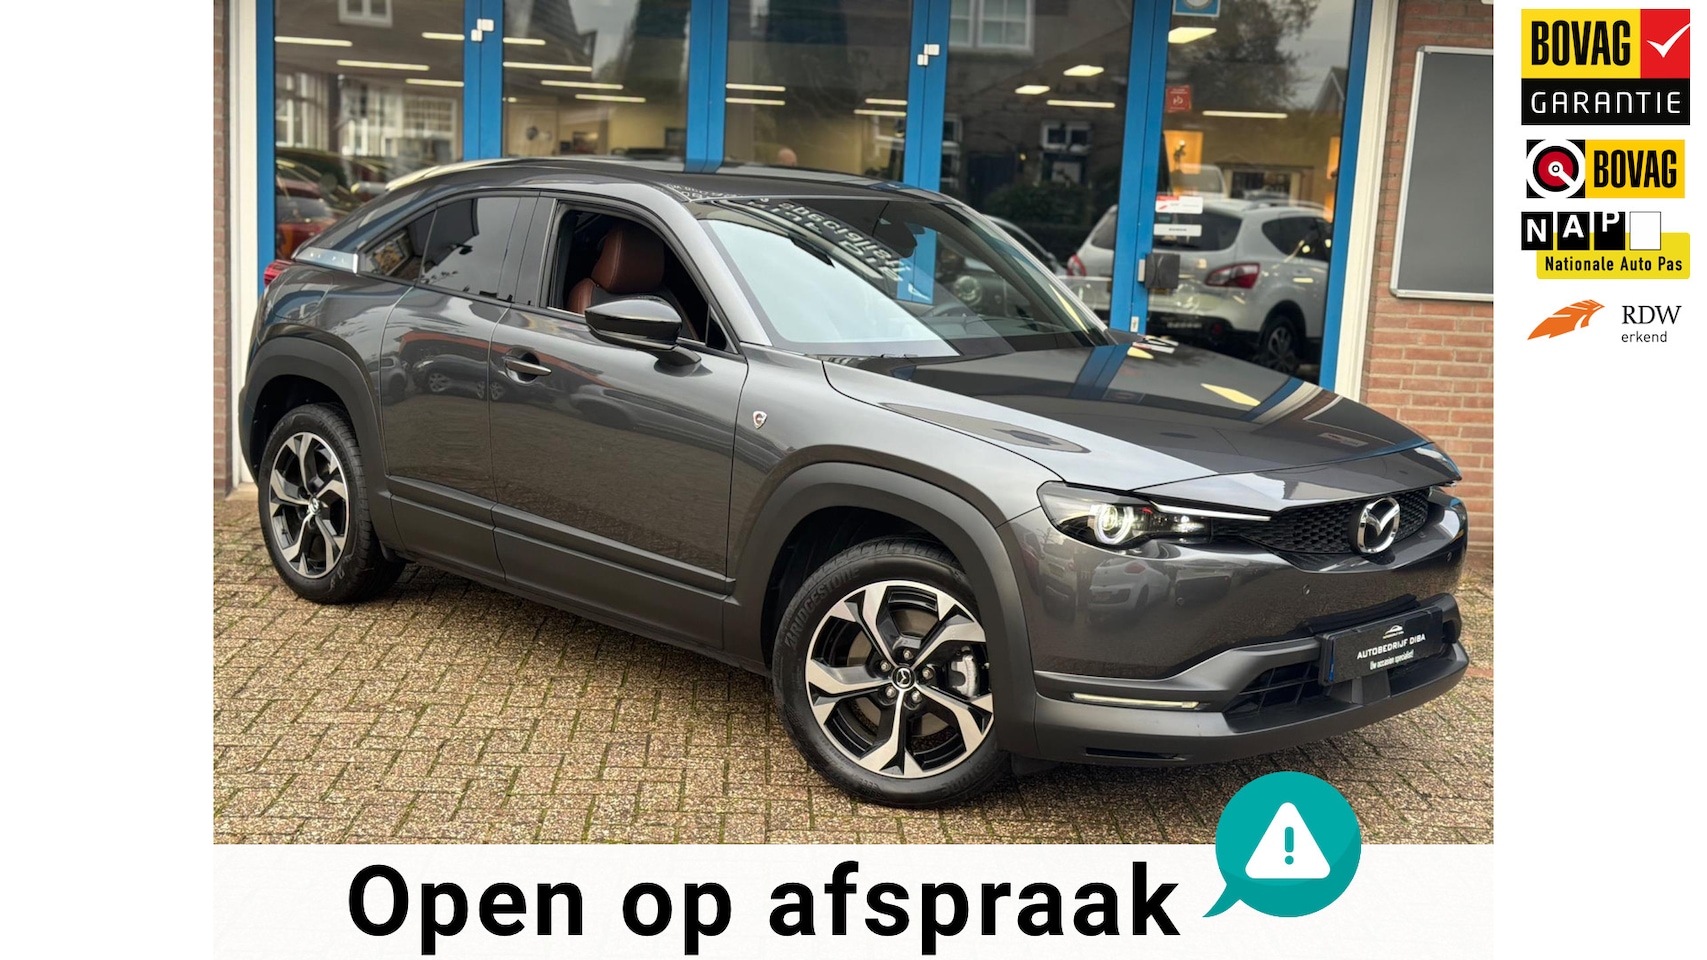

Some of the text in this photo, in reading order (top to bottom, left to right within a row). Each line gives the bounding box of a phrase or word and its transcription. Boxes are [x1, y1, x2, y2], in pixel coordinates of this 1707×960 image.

[784, 566, 861, 650] BRIDGESTONE
[1356, 638, 1409, 660] AUTOBEDRIJF
[1409, 633, 1426, 645] DIBA
